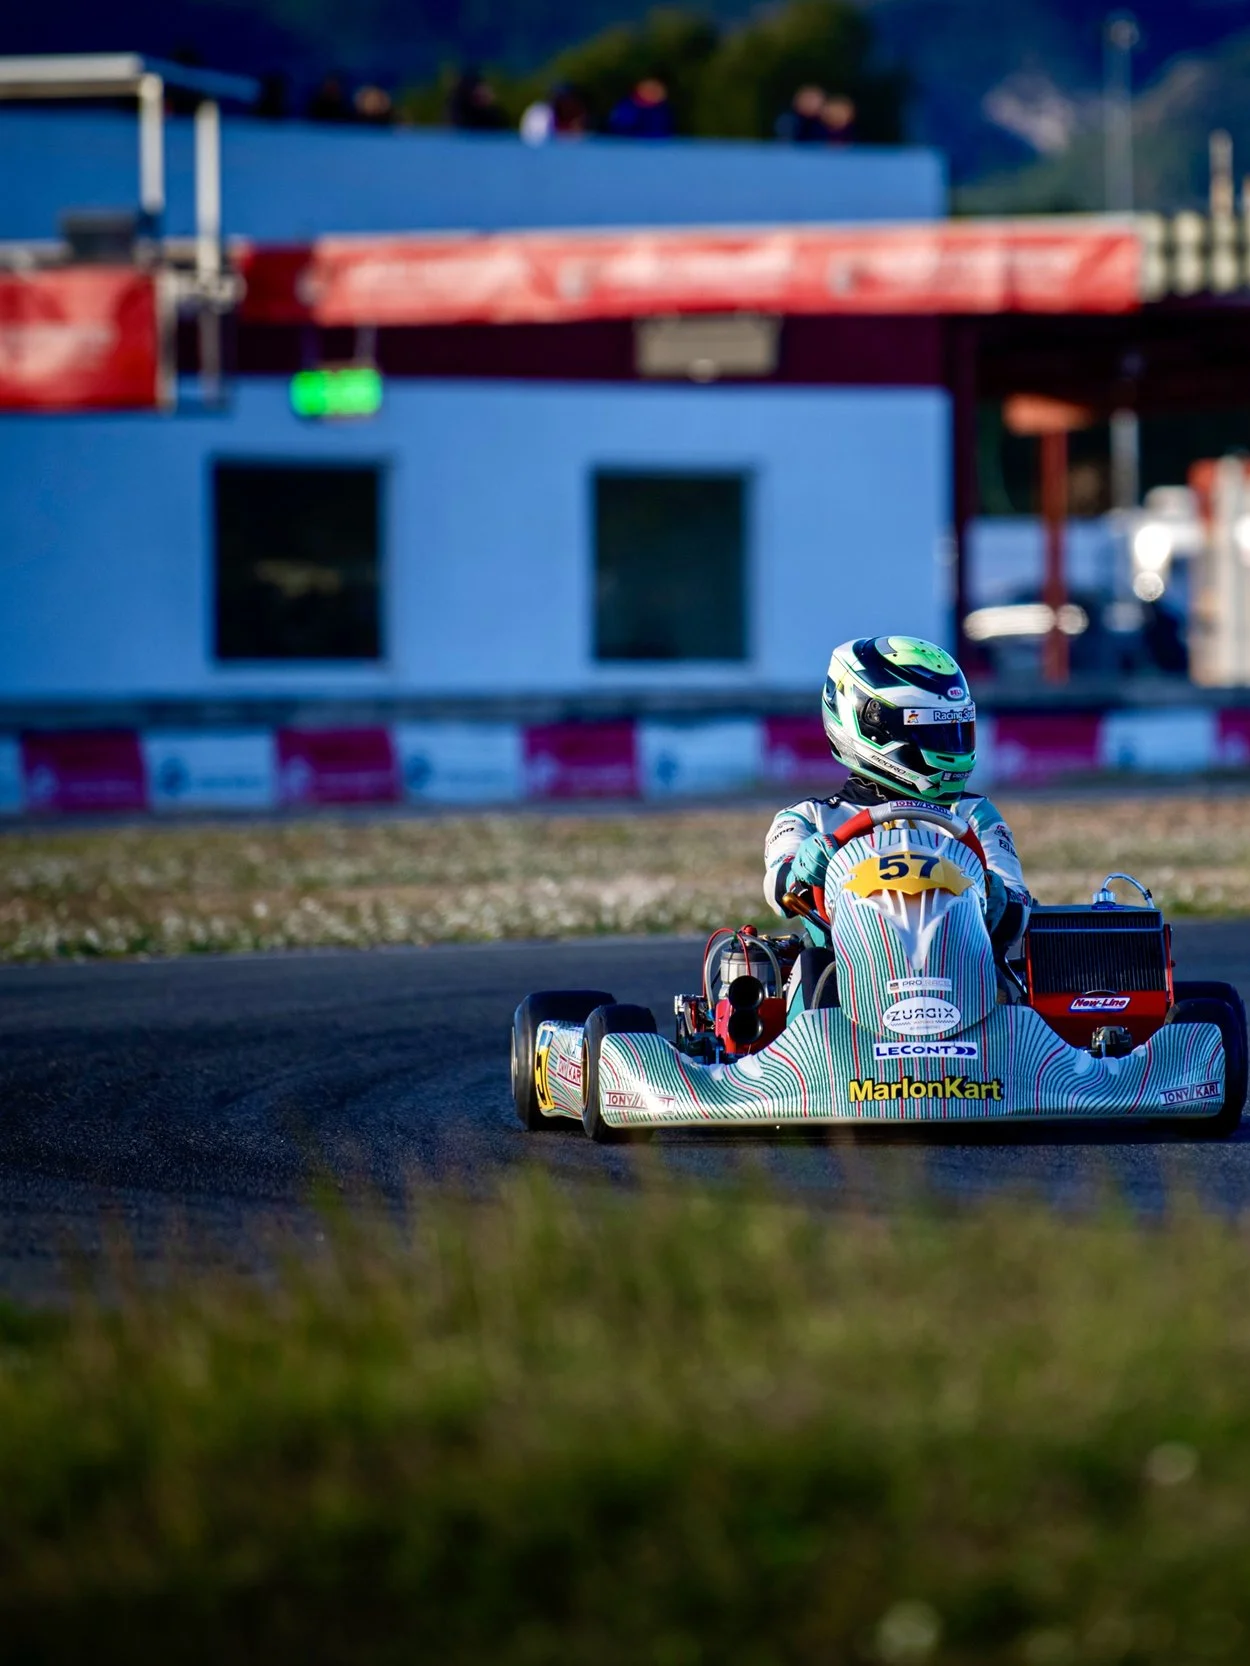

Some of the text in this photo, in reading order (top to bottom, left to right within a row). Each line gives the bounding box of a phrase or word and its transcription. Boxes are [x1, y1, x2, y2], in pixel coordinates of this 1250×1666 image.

[933, 709, 964, 721] Racing
[879, 854, 940, 880] 57
[1073, 998, 1127, 1007] New-Line
[850, 1076, 1003, 1103] MarlonKart
[1160, 1081, 1219, 1104] TONY KART
[606, 1092, 634, 1107] TONY
